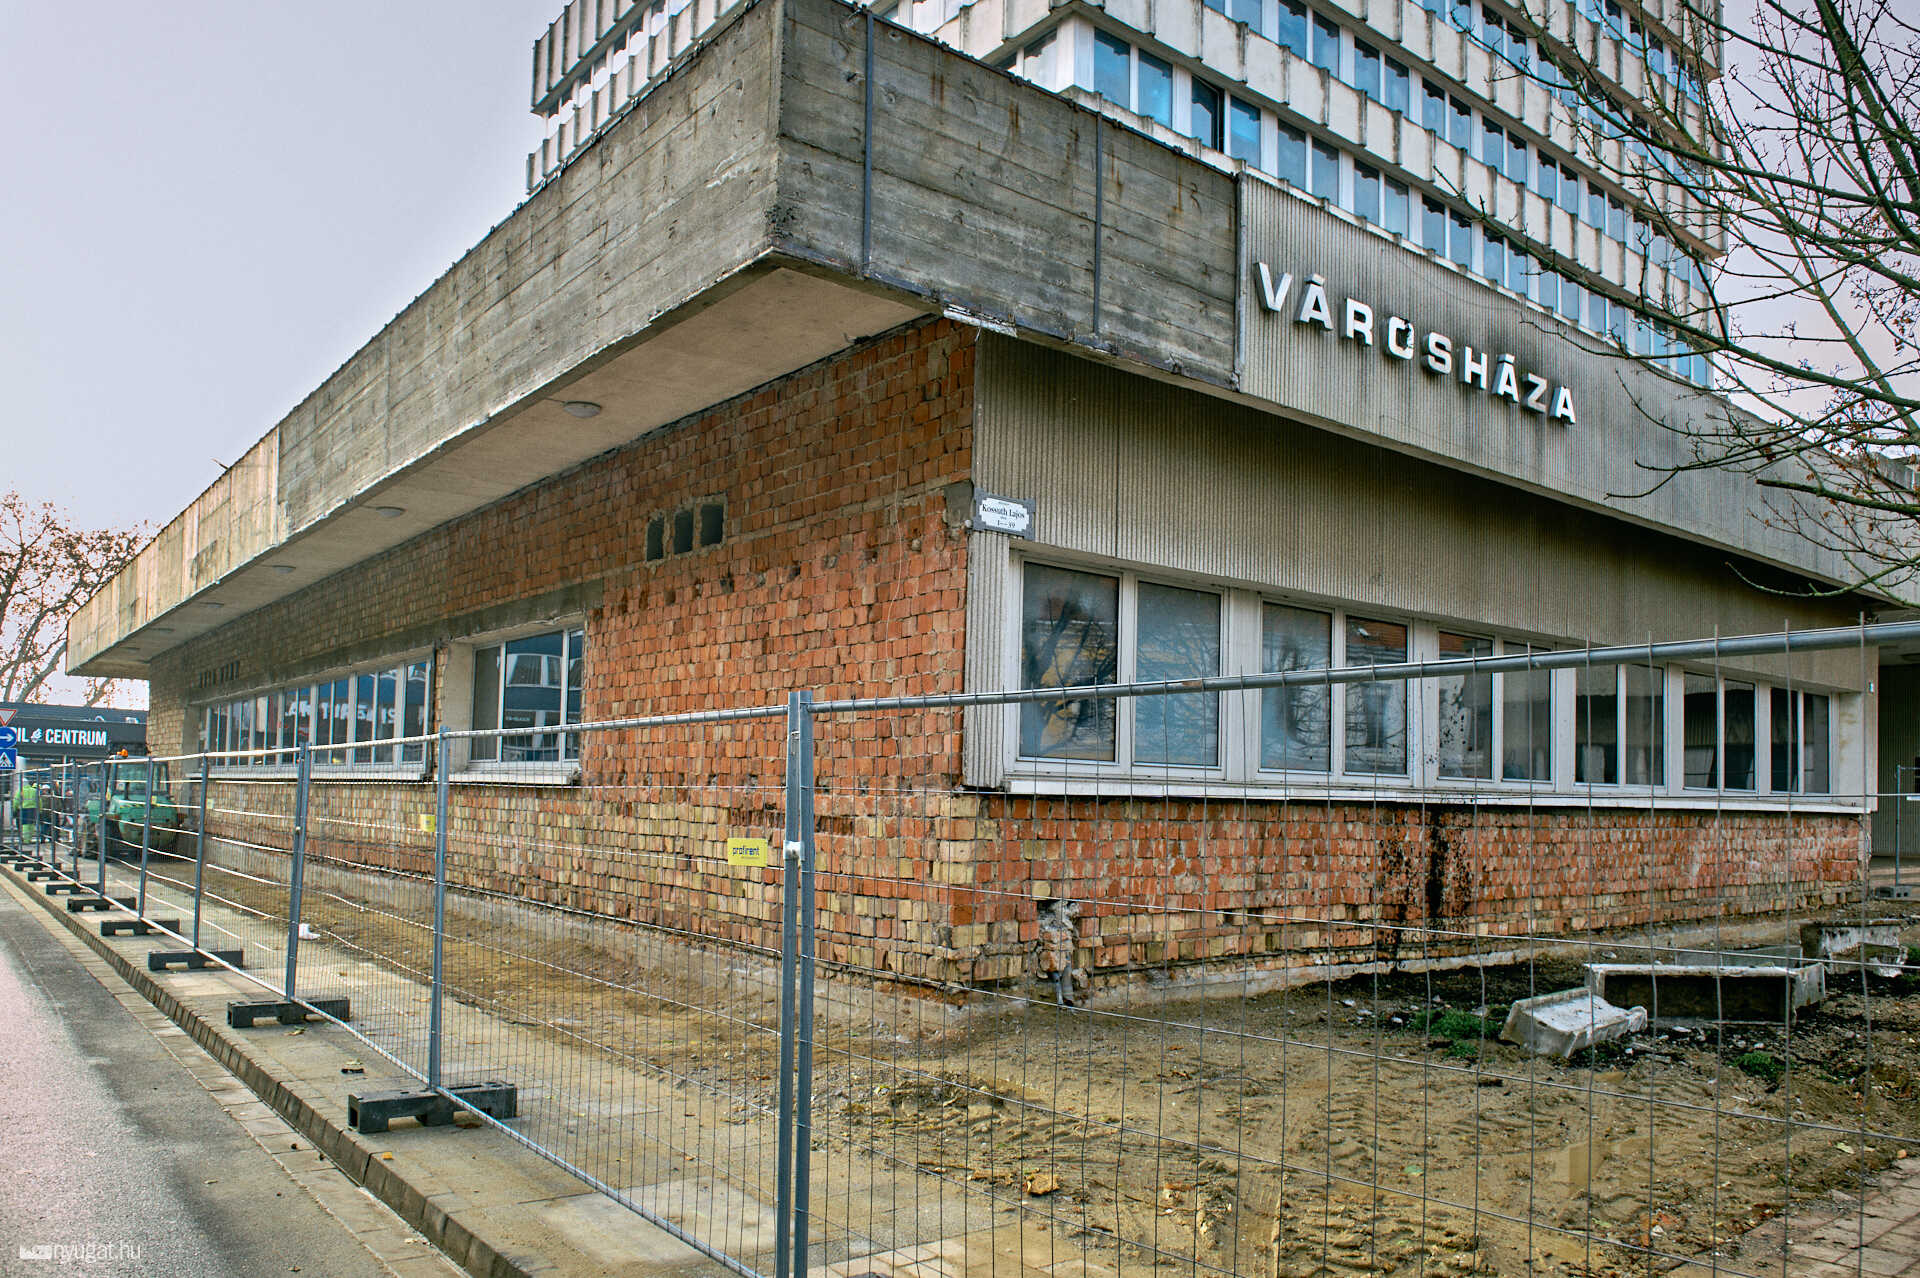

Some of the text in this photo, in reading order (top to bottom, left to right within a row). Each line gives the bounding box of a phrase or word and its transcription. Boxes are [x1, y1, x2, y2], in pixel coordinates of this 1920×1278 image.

[1254, 261, 1577, 425] VÁROSHÁZA
[982, 503, 1025, 520] Kossuth Lajos
[10, 727, 107, 746] IL CENTRUM
